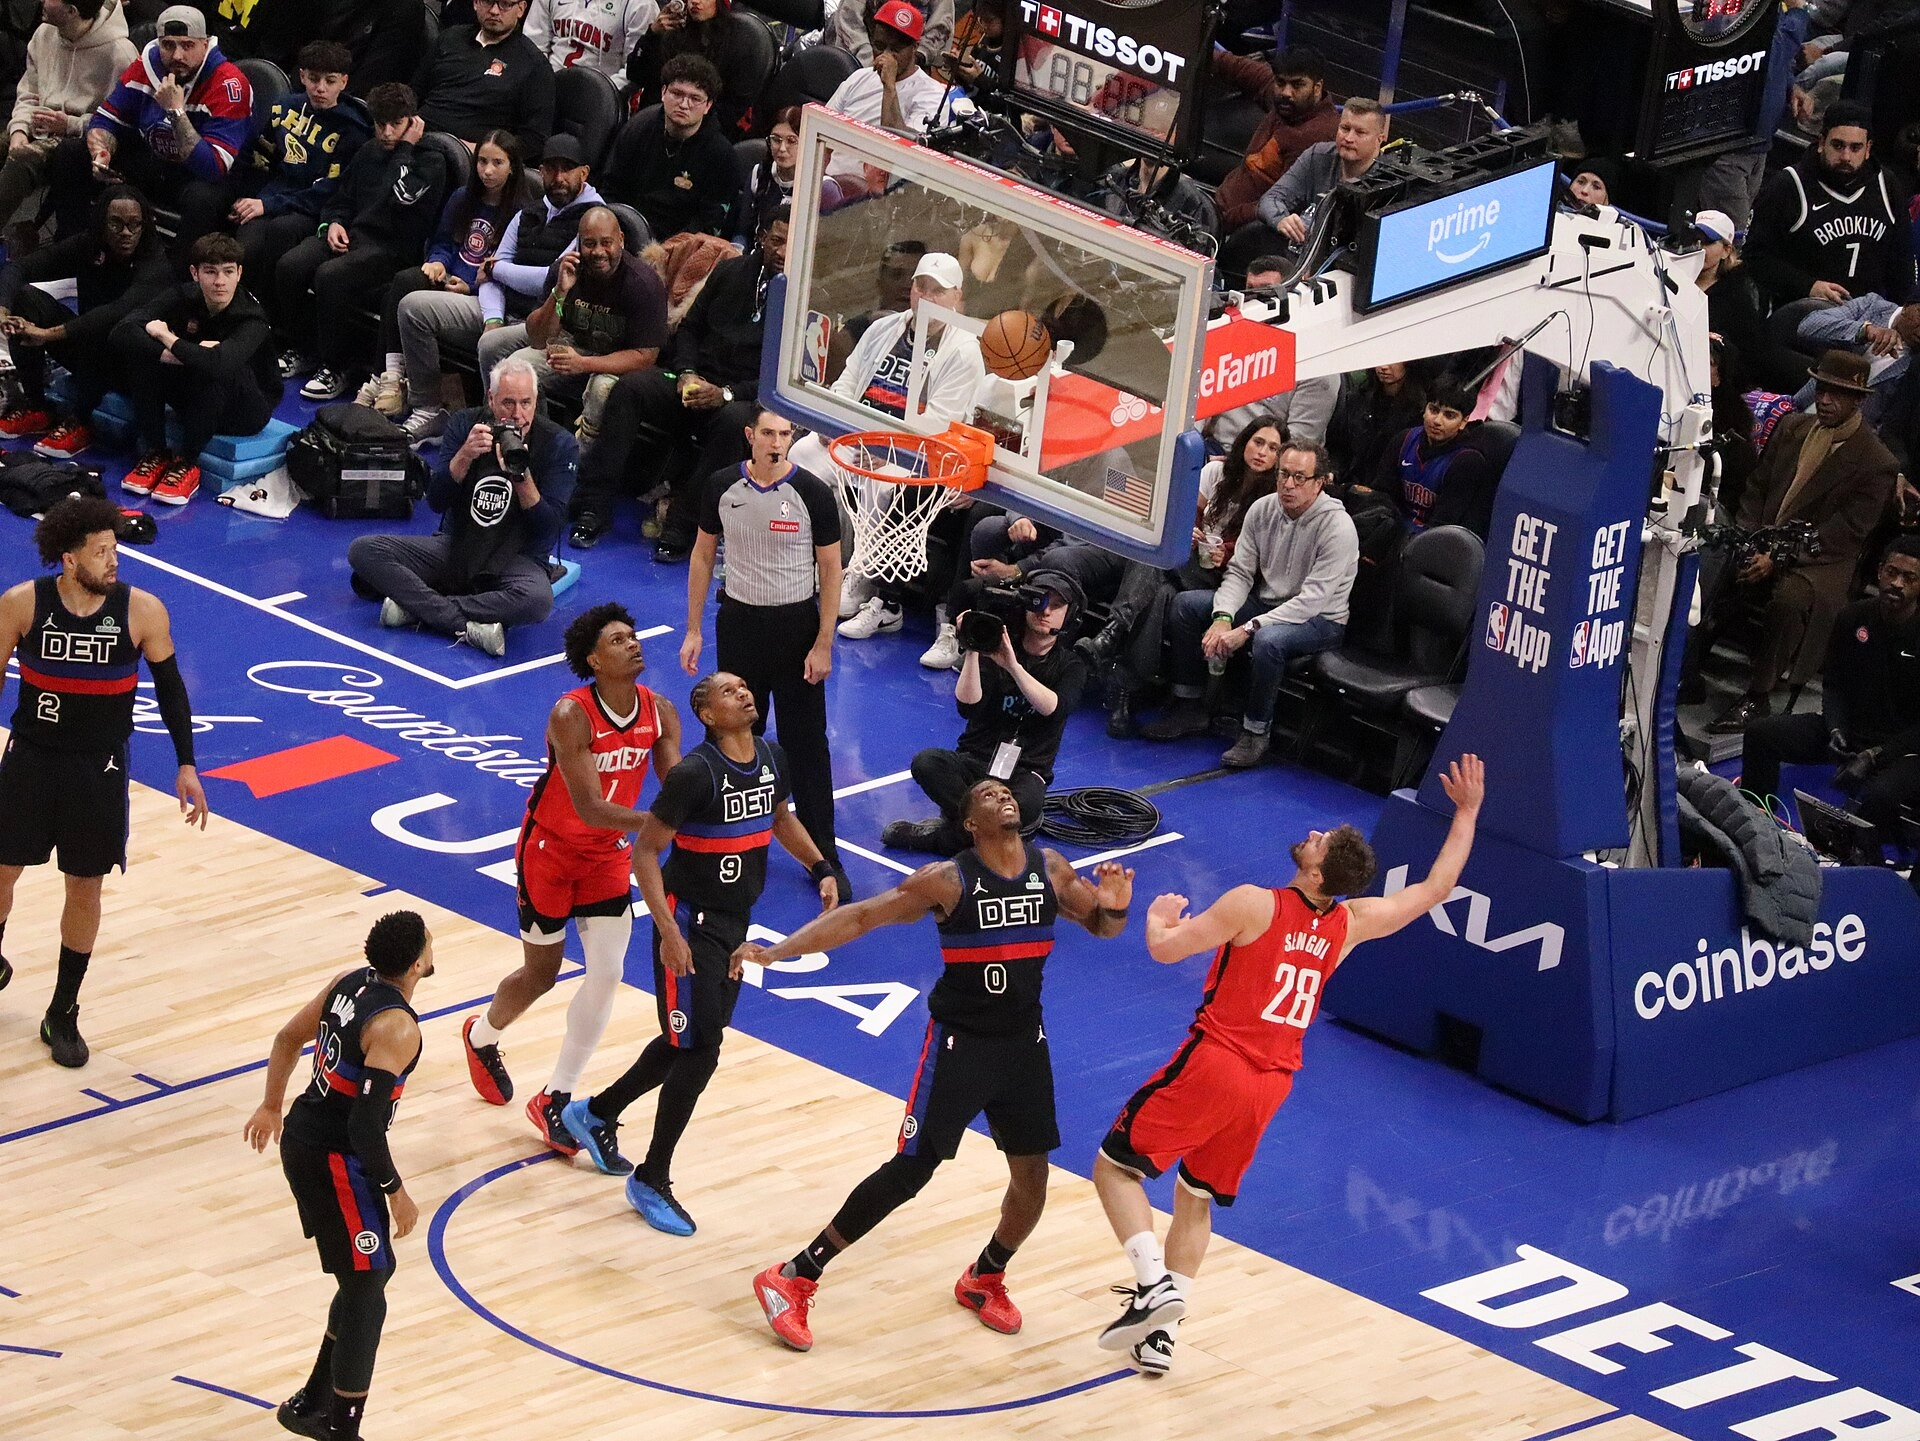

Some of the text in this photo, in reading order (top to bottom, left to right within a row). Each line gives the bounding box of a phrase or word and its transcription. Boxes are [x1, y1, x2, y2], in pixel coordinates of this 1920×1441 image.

[1065, 14, 1185, 82] TISSOT
[1694, 51, 1766, 85] TISSOT
[1427, 199, 1501, 252] prime
[1813, 215, 1887, 246] BROOKLYN
[1846, 242, 1861, 278] 7
[865, 354, 913, 386] DE
[770, 522, 799, 531] Emirates
[1511, 512, 1558, 567] GET
[1591, 519, 1631, 570] GET
[1506, 557, 1551, 615] THE
[1587, 565, 1625, 616] THE
[41, 630, 118, 663] DET
[1504, 609, 1551, 674] App
[1586, 617, 1625, 669] App
[37, 692, 60, 723] 2
[246, 660, 549, 788] Courtsi
[605, 779, 620, 802] 1
[723, 784, 775, 822] DET
[719, 854, 742, 883] 9
[977, 893, 1044, 929] DET
[983, 963, 1007, 995] 0
[1634, 913, 1867, 1020] coinbase
[1260, 962, 1322, 1029] 28
[359, 1237, 375, 1248] DET
